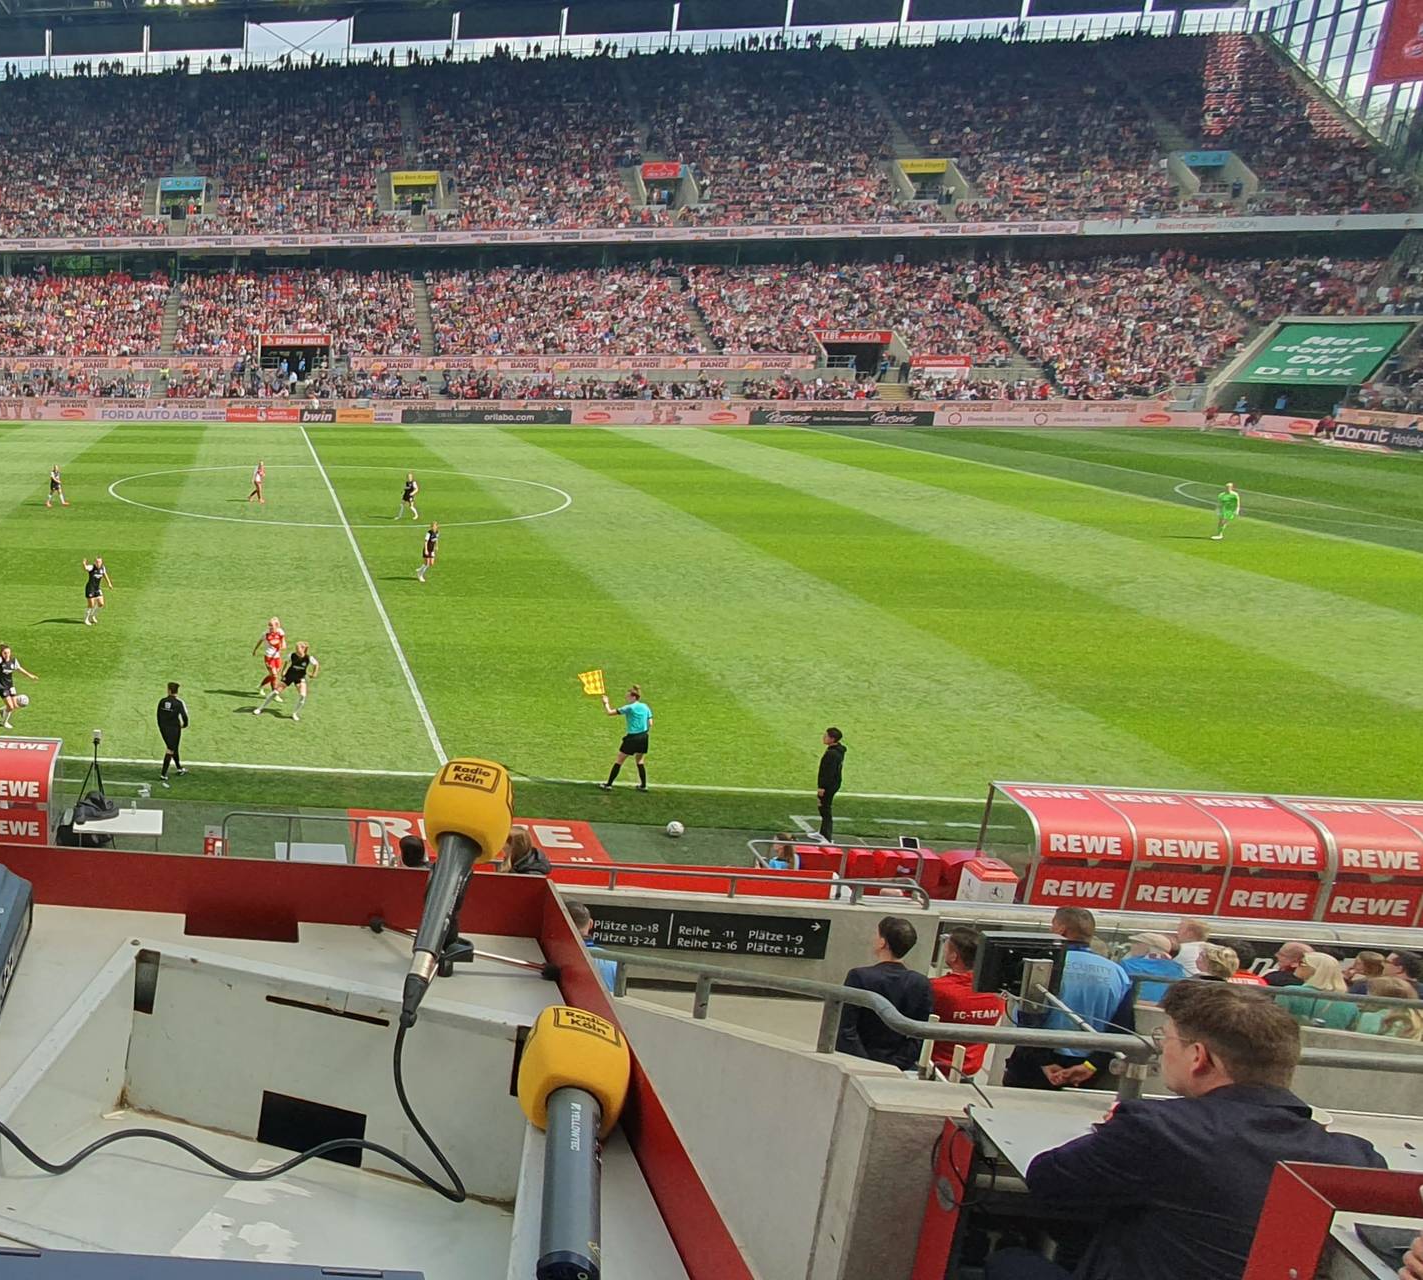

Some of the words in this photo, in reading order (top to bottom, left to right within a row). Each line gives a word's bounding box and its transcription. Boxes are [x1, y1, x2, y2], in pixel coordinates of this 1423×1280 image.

[1254, 366, 1357, 377] DEVK
[102, 409, 135, 419] FORD
[136, 409, 168, 419] AUTO
[170, 409, 198, 420] ABO
[302, 411, 333, 422] bwin
[1335, 424, 1390, 443] Dorint
[453, 764, 491, 778] Radio
[453, 772, 484, 786] Köln
[1014, 788, 1090, 800] REWE
[1103, 792, 1181, 804] REWE
[1193, 797, 1274, 809] REWE
[1287, 802, 1373, 814] REWE
[366, 816, 585, 850] RE
[1049, 833, 1123, 855] REWE
[1145, 838, 1220, 860] REWE
[1240, 843, 1318, 865] REWE
[1342, 848, 1421, 871] REWE
[1041, 879, 1116, 899] REWE
[1135, 884, 1212, 905] REWE
[1229, 889, 1308, 910] REWE
[1330, 895, 1410, 917] REWE
[594, 920, 628, 932] Plätze
[630, 923, 659, 934] 10-18
[679, 925, 710, 937] Reihe
[748, 930, 784, 942] Plätze
[785, 934, 803, 945] 1-9
[592, 932, 626, 944] Plätze
[629, 936, 657, 947] 13-24
[677, 937, 709, 949] Reihe
[711, 941, 737, 951] 12-16
[746, 942, 781, 954] Plätze
[784, 946, 804, 956] 1-12
[565, 1010, 610, 1031] Radio
[953, 1009, 1000, 1021] FC-TEAM
[569, 1017, 607, 1036] Köln
